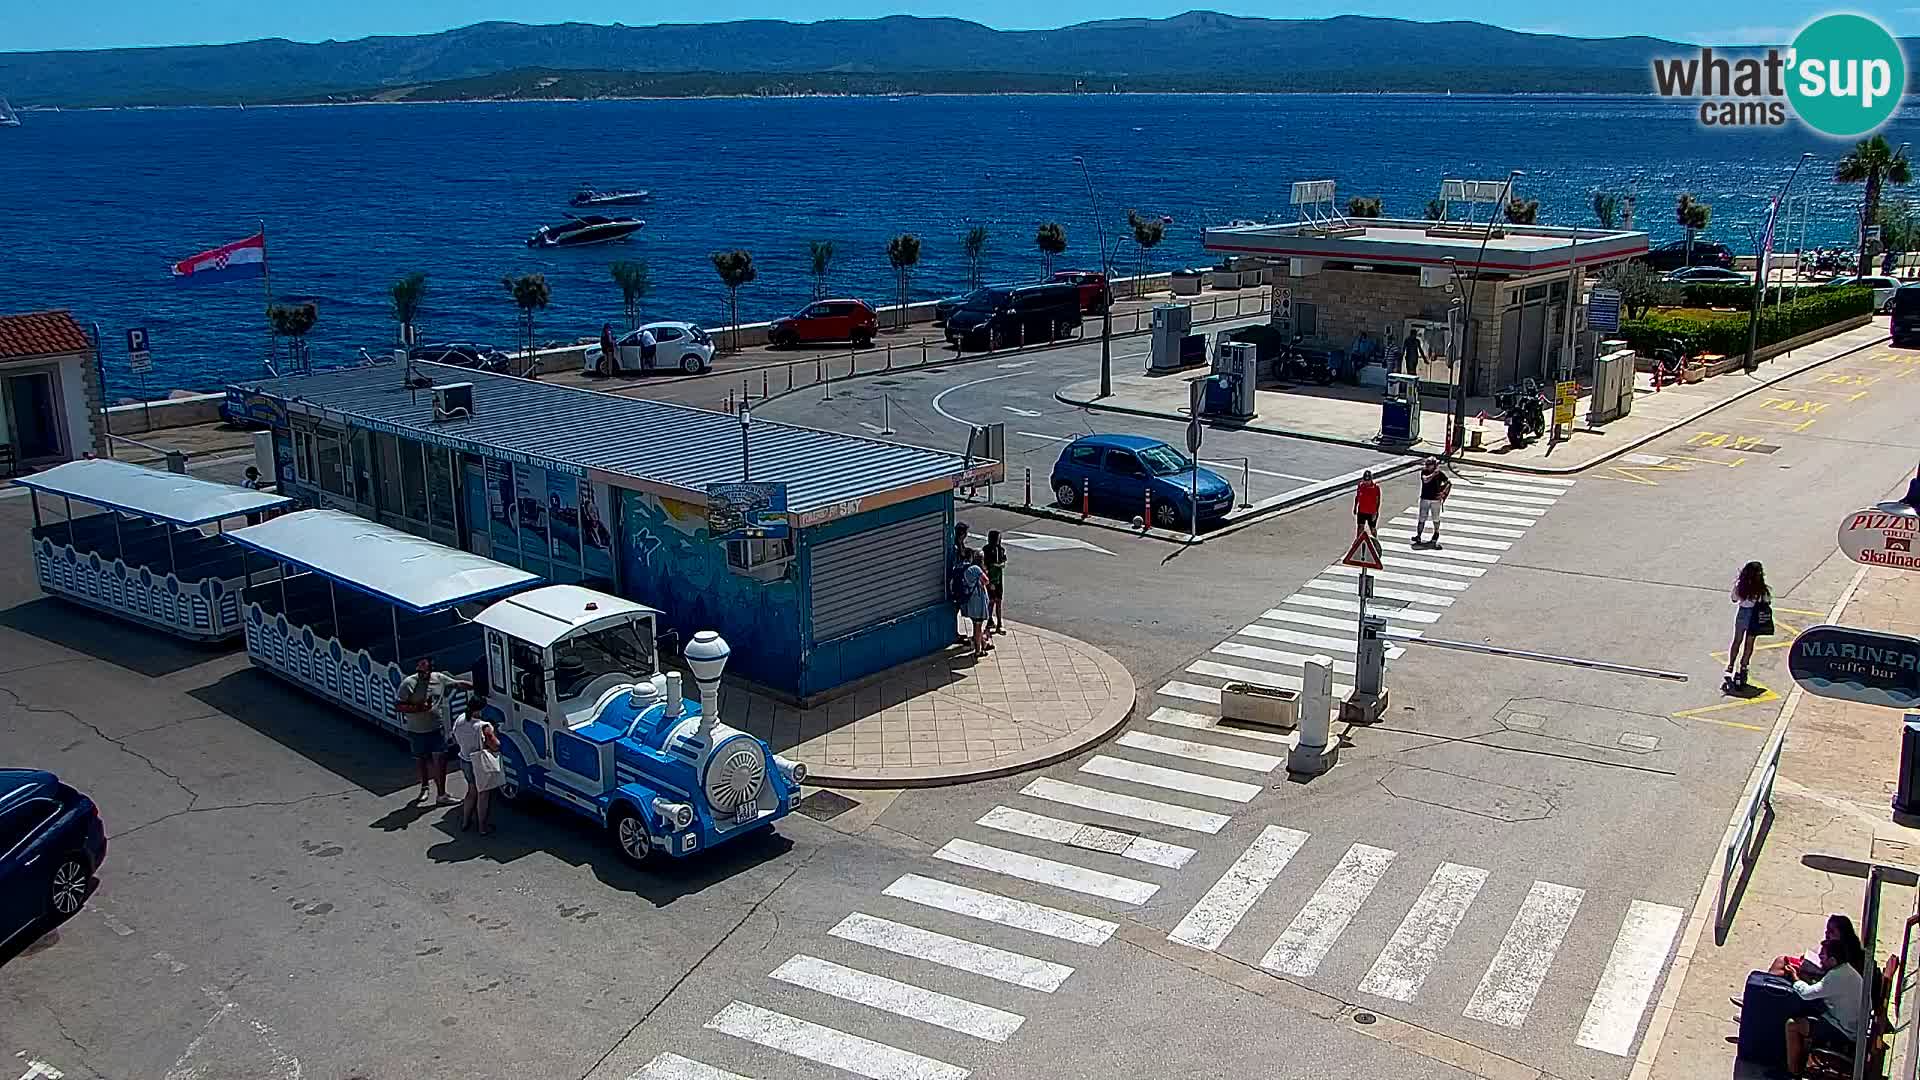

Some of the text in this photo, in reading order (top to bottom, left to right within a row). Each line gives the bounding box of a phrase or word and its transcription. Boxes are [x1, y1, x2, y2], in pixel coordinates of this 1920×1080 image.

[1760, 398, 1832, 412] TAXI
[1686, 431, 1765, 450] TAXI
[438, 436, 468, 450] POSTAJA
[480, 445, 494, 457] BUS
[495, 450, 527, 465] STATION
[529, 457, 554, 471] TICKET
[556, 463, 583, 477] OFFICE
[1848, 514, 1920, 533] PIZZE
[1802, 641, 1920, 672] MARINER
[1829, 661, 1897, 679] caffe bar
